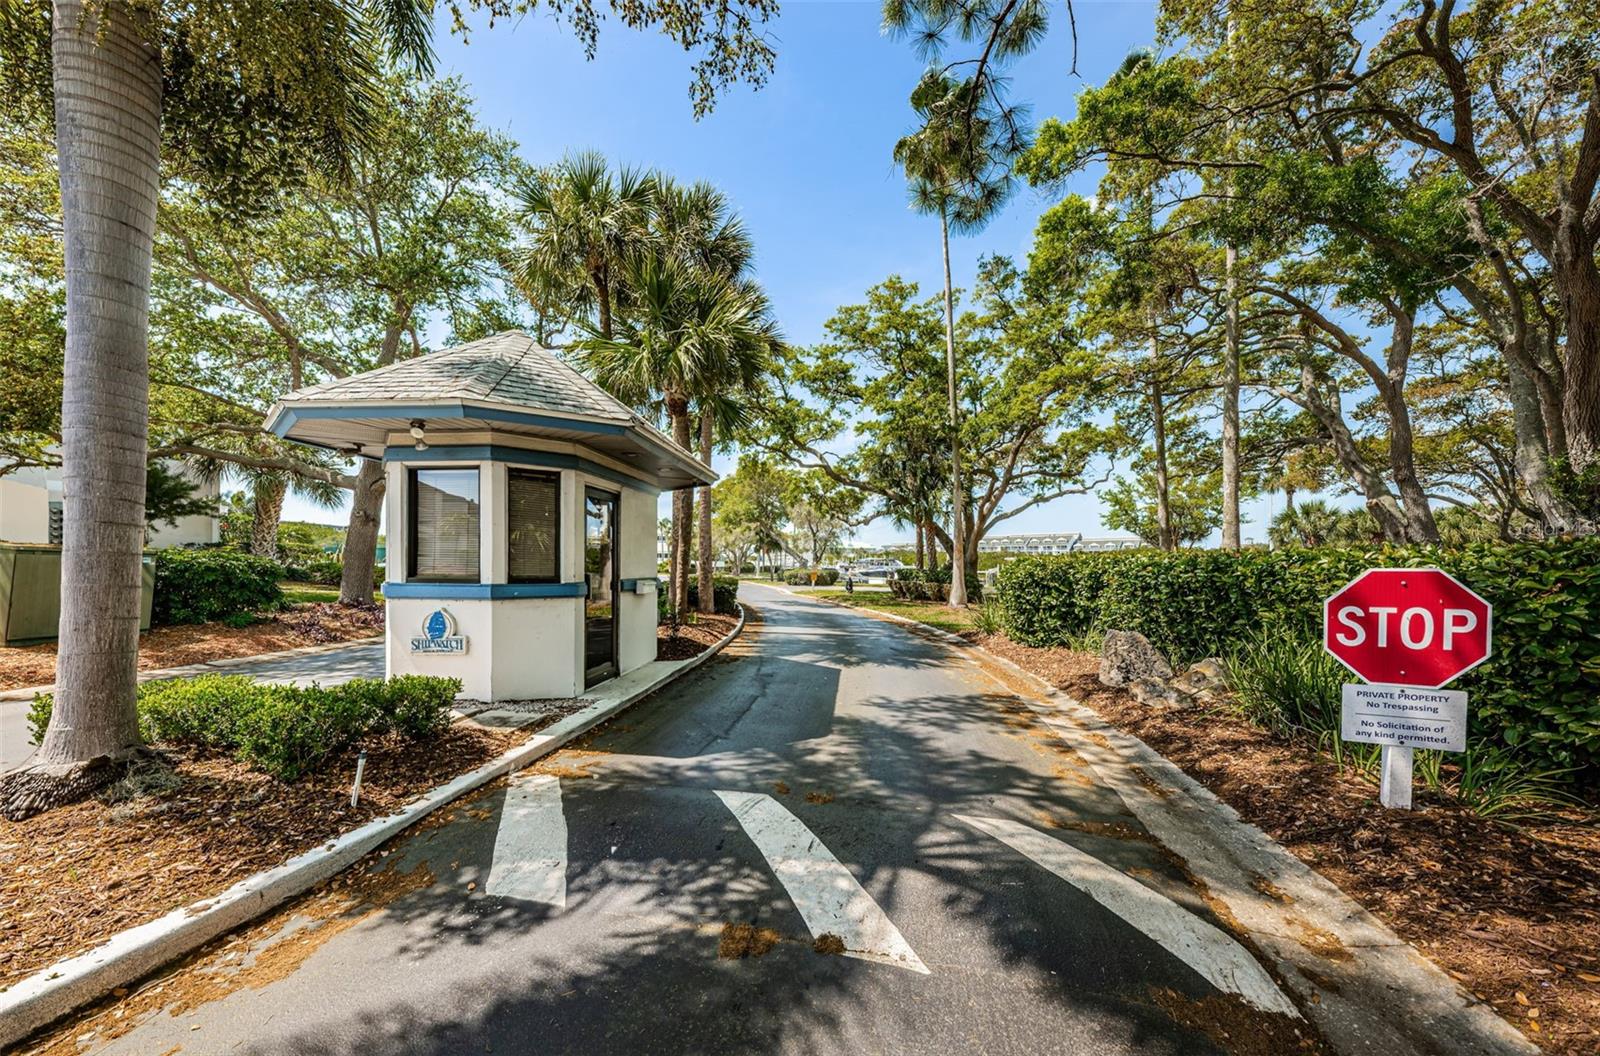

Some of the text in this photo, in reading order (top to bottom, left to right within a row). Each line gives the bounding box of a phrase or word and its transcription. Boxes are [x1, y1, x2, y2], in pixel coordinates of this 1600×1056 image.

[1336, 605, 1478, 651] STOP
[1356, 690, 1450, 703] PRIVATE PROPERTY
[1382, 702, 1439, 714] Trespassing
[1361, 720, 1375, 728] No
[1377, 721, 1431, 733] Solicitation
[1355, 730, 1450, 745] any kind permitted.
